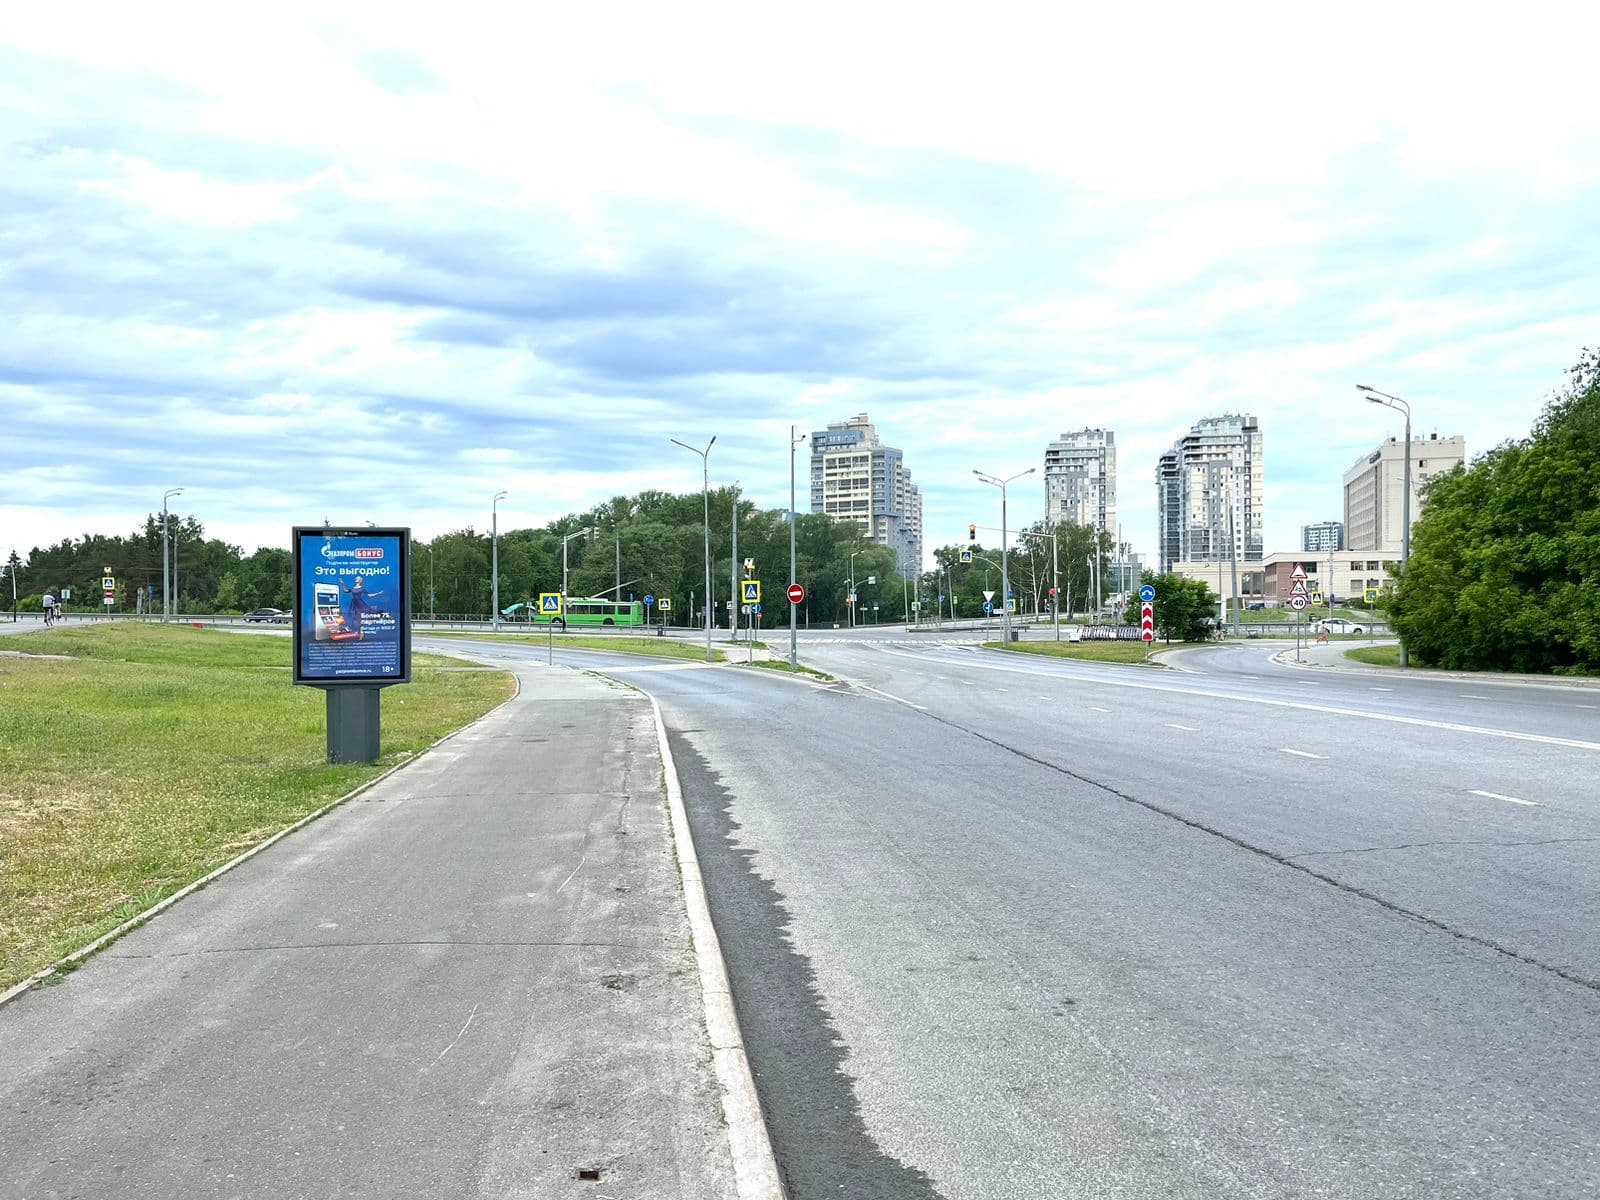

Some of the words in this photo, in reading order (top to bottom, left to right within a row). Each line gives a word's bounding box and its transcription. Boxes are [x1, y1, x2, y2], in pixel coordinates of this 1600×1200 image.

[315, 566, 337, 575] Это
[339, 566, 390, 576] выгодно!
[382, 665, 394, 673] 18+
